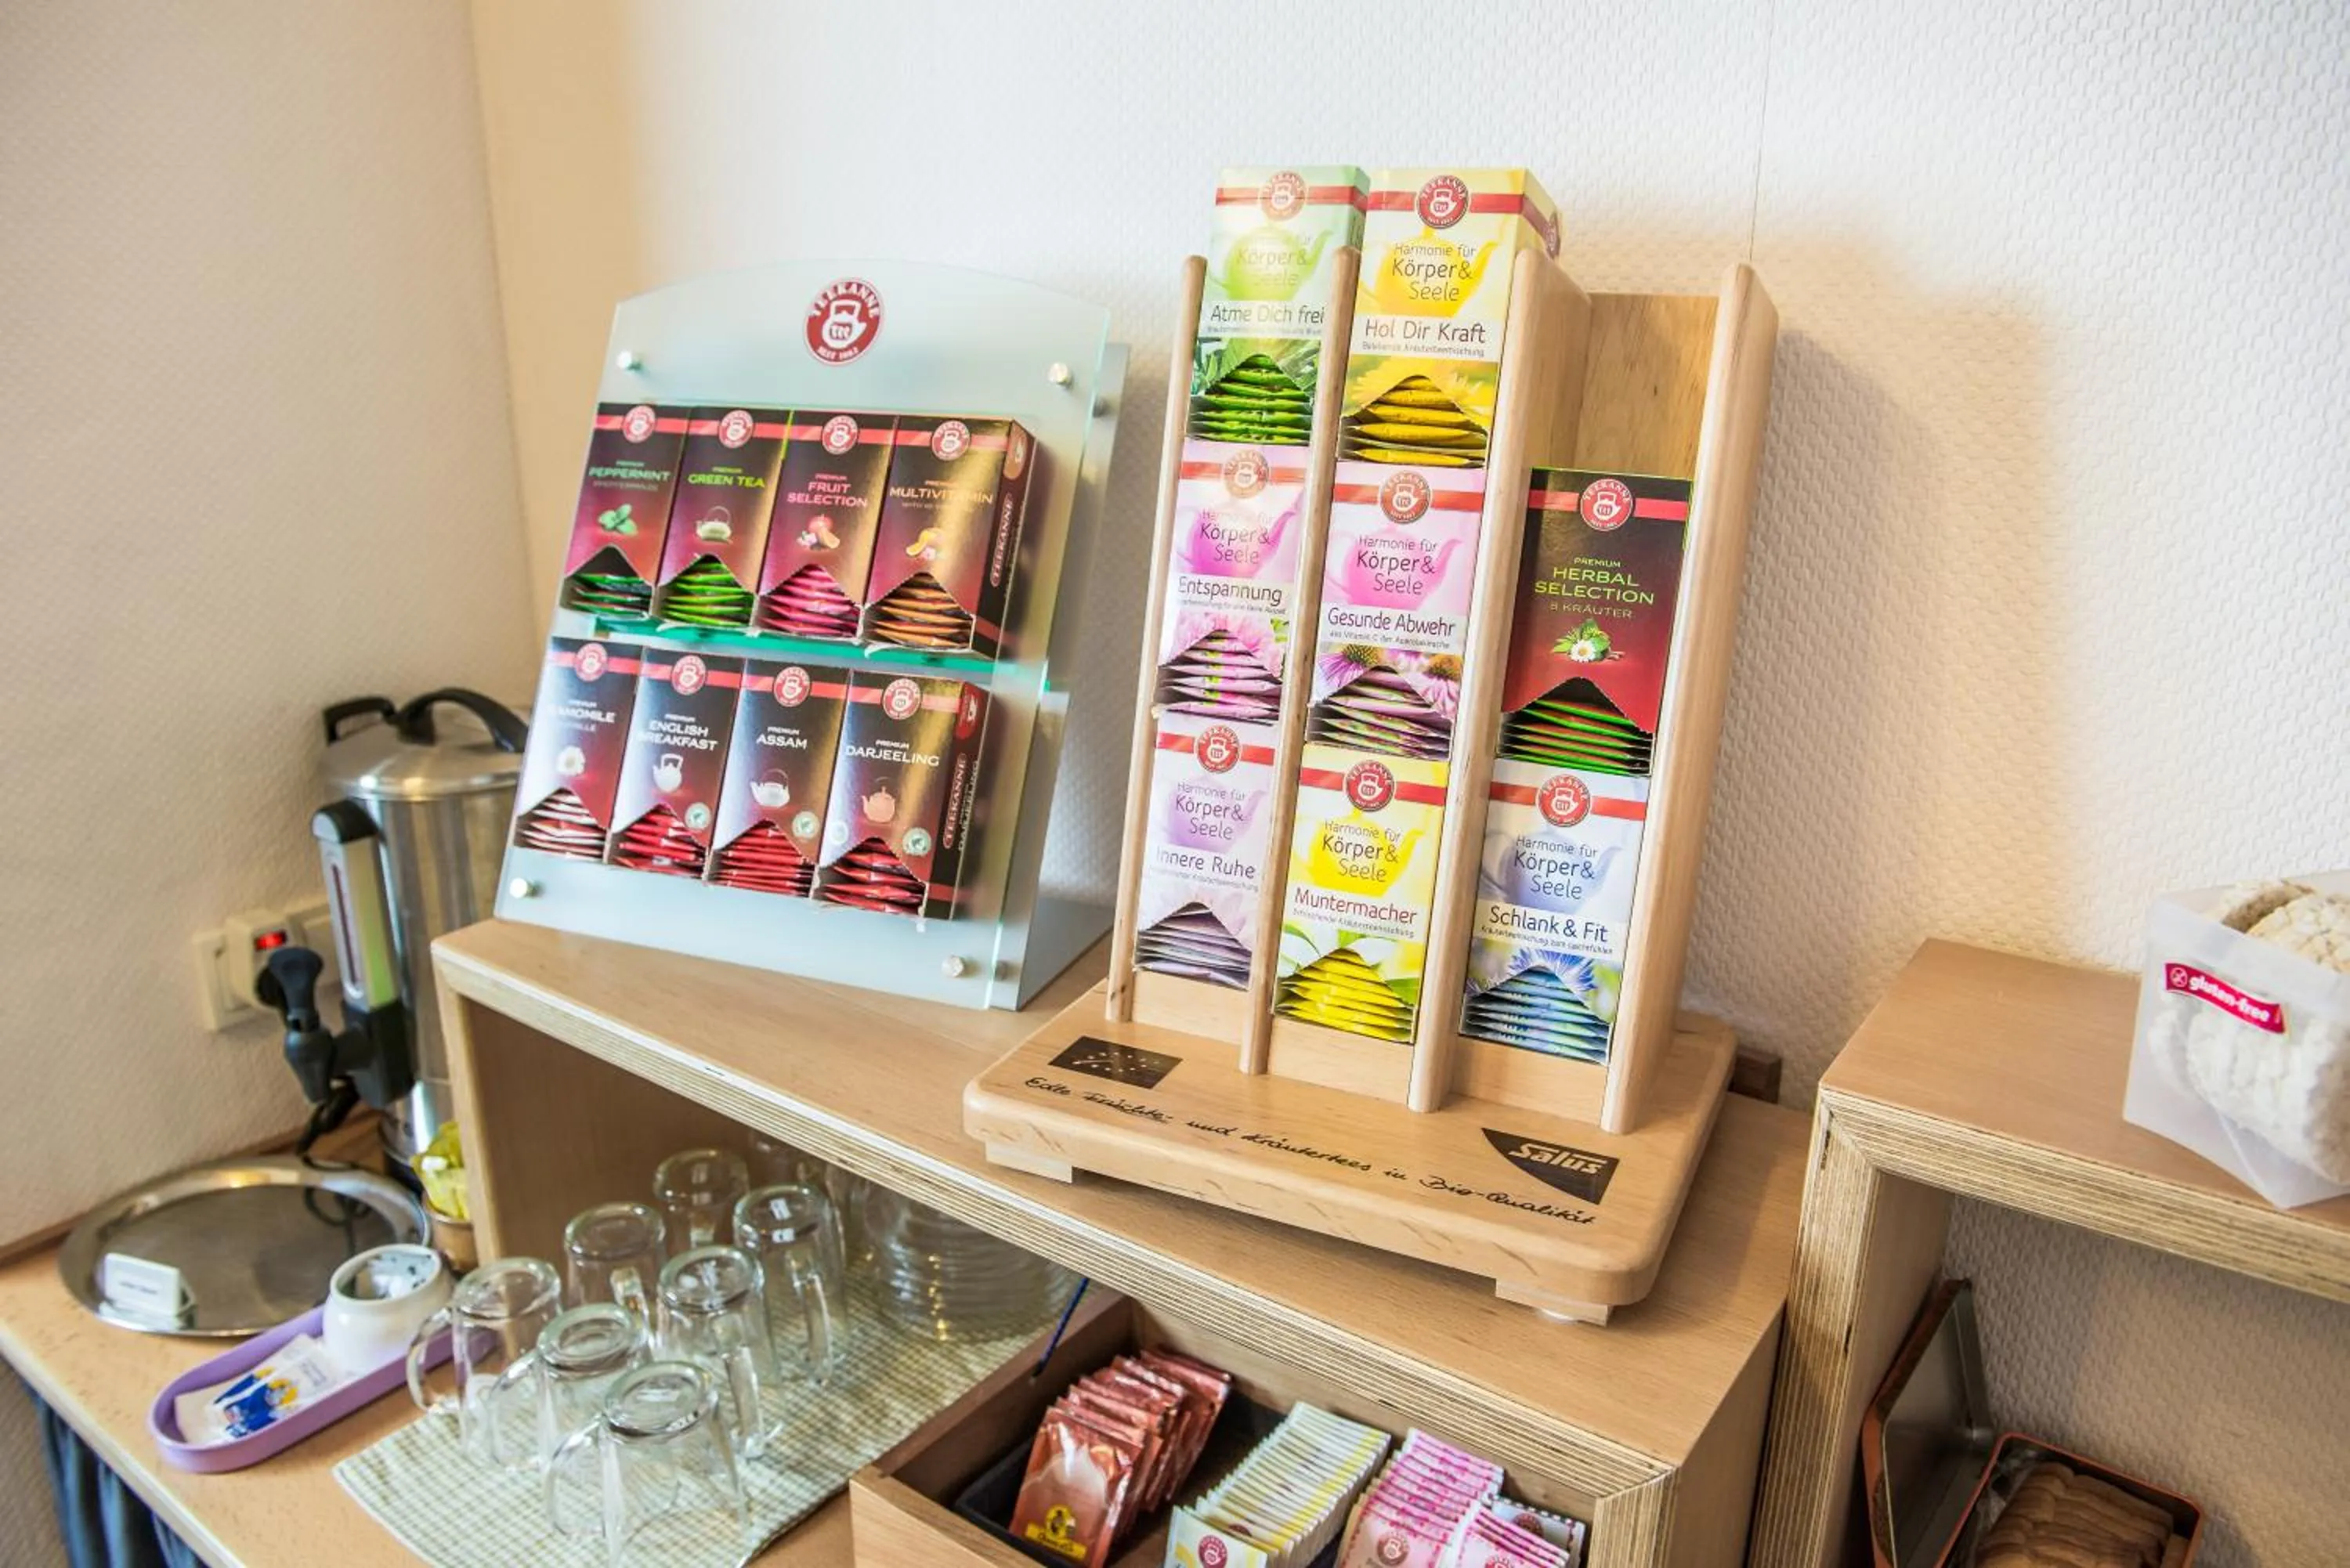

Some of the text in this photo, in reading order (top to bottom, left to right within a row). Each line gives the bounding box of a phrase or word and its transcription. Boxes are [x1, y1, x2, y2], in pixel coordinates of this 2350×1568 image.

[1394, 244, 1476, 257] Harmonie für
[808, 280, 880, 318] TEEKANNE
[1409, 282, 1459, 302] Seele
[1210, 305, 1325, 324] Atme Dich frei
[1365, 320, 1486, 343] Hol Dir Kraft
[588, 467, 671, 481] PEPPERMINT
[688, 473, 765, 488] GREEN TEA
[808, 482, 851, 493] FRUIT
[889, 486, 993, 504] MULTIVITMIN
[786, 492, 868, 508] SELECTION
[1214, 544, 1260, 564] Seele
[1358, 535, 1438, 551] Harmonie für
[1574, 557, 1621, 568] PREMIUM
[1373, 573, 1423, 595] Seele
[1553, 567, 1640, 587] HERBAL
[1178, 576, 1282, 606] Entspannung
[1535, 580, 1654, 605] SELECTION
[1563, 602, 1632, 618] KRÄUTER
[1328, 607, 1456, 637] Gesunde Abwehr
[649, 720, 709, 737] ENGLISH
[756, 733, 808, 750] ASSAM
[875, 739, 909, 749] PREMIUM
[845, 745, 940, 768] DARJEELING
[1177, 782, 1226, 800] Harmonie
[1190, 817, 1233, 840] Seele
[1325, 820, 1401, 843] Harmonie für
[1516, 836, 1598, 858] Harmonie für
[1156, 845, 1256, 879] Innere Ruhe
[1339, 858, 1387, 883] Seele
[1531, 874, 1582, 900] Seele
[1295, 886, 1417, 924] Muntermacher
[1489, 905, 1608, 942] Schlank & Fit
[2189, 976, 2271, 1022] gluten-free
[1509, 1142, 1609, 1175] Salus
[1185, 1119, 1238, 1136] und
[1242, 1133, 1372, 1172] Kräutertees
[1383, 1167, 1408, 1180] in
[1418, 1174, 1596, 1225] Bio-Qualität
